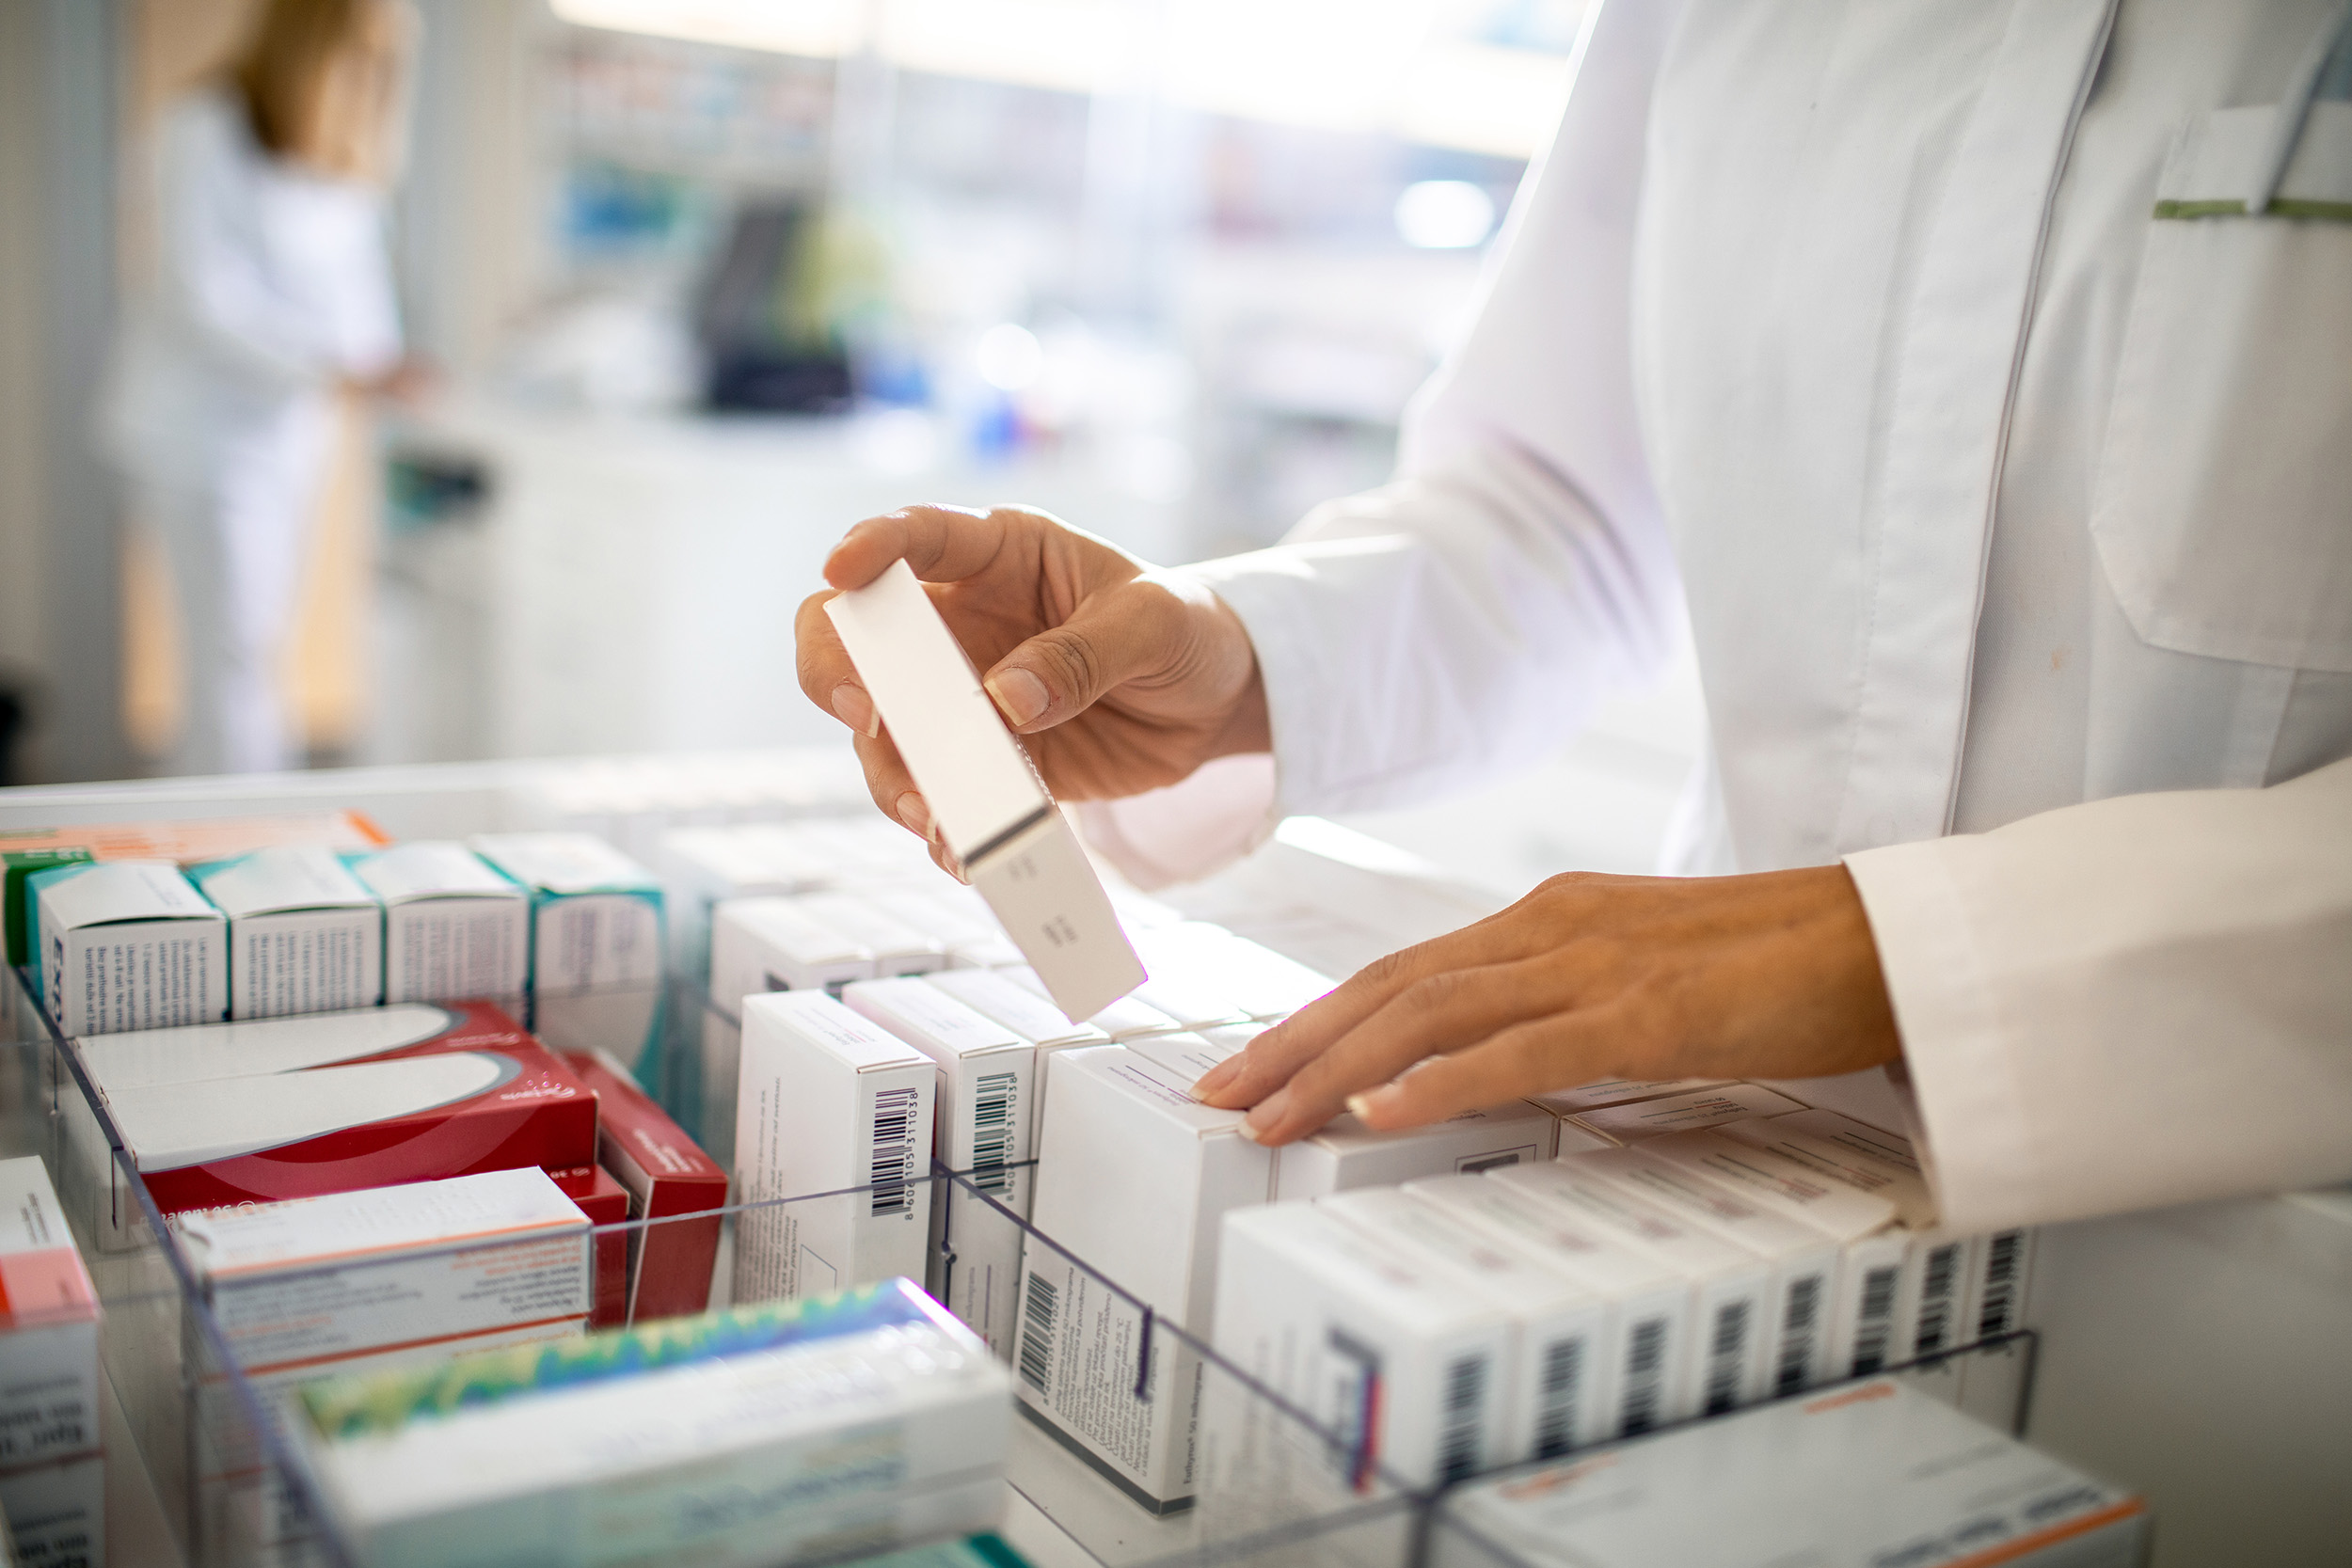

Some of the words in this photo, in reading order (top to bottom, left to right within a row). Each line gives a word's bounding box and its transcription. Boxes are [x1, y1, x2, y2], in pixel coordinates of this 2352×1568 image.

[906, 1092, 918, 1143] 311038
[1006, 1076, 1018, 1127] 311038
[1065, 1268, 1073, 1318] mikrograma
[1064, 1320, 1069, 1330] 50
[1188, 1361, 1204, 1418] mikrograma
[1187, 1420, 1197, 1433] 50
